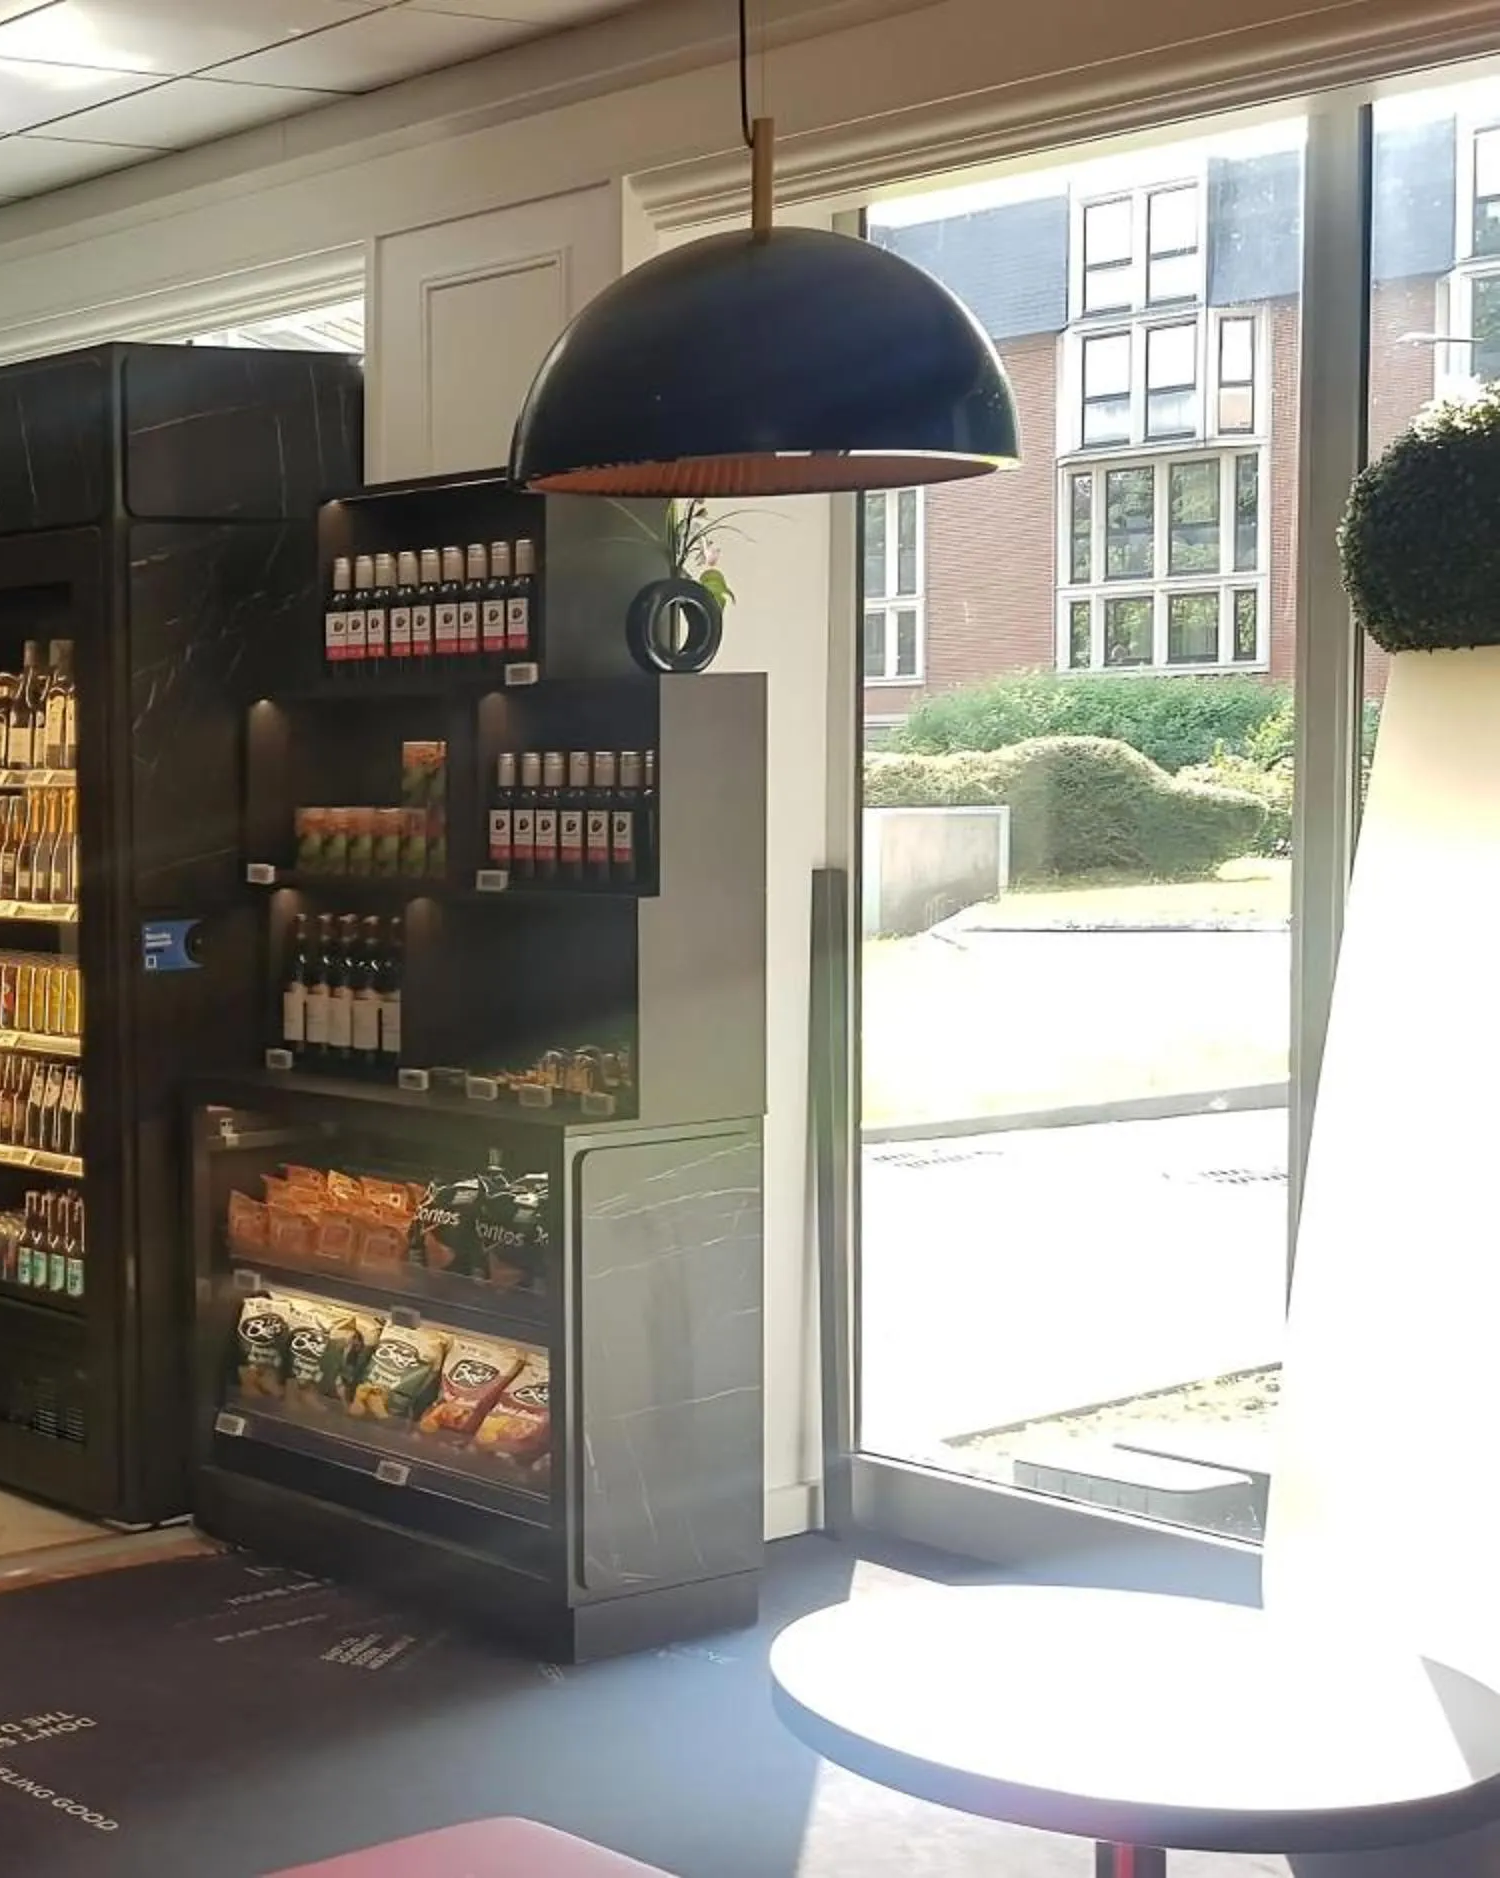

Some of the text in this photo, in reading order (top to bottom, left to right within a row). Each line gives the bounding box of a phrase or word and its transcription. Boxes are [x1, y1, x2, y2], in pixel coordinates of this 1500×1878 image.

[20, 1717, 98, 1742] DON'T
[22, 1711, 76, 1728] THE
[52, 1798, 119, 1830] GOOD
